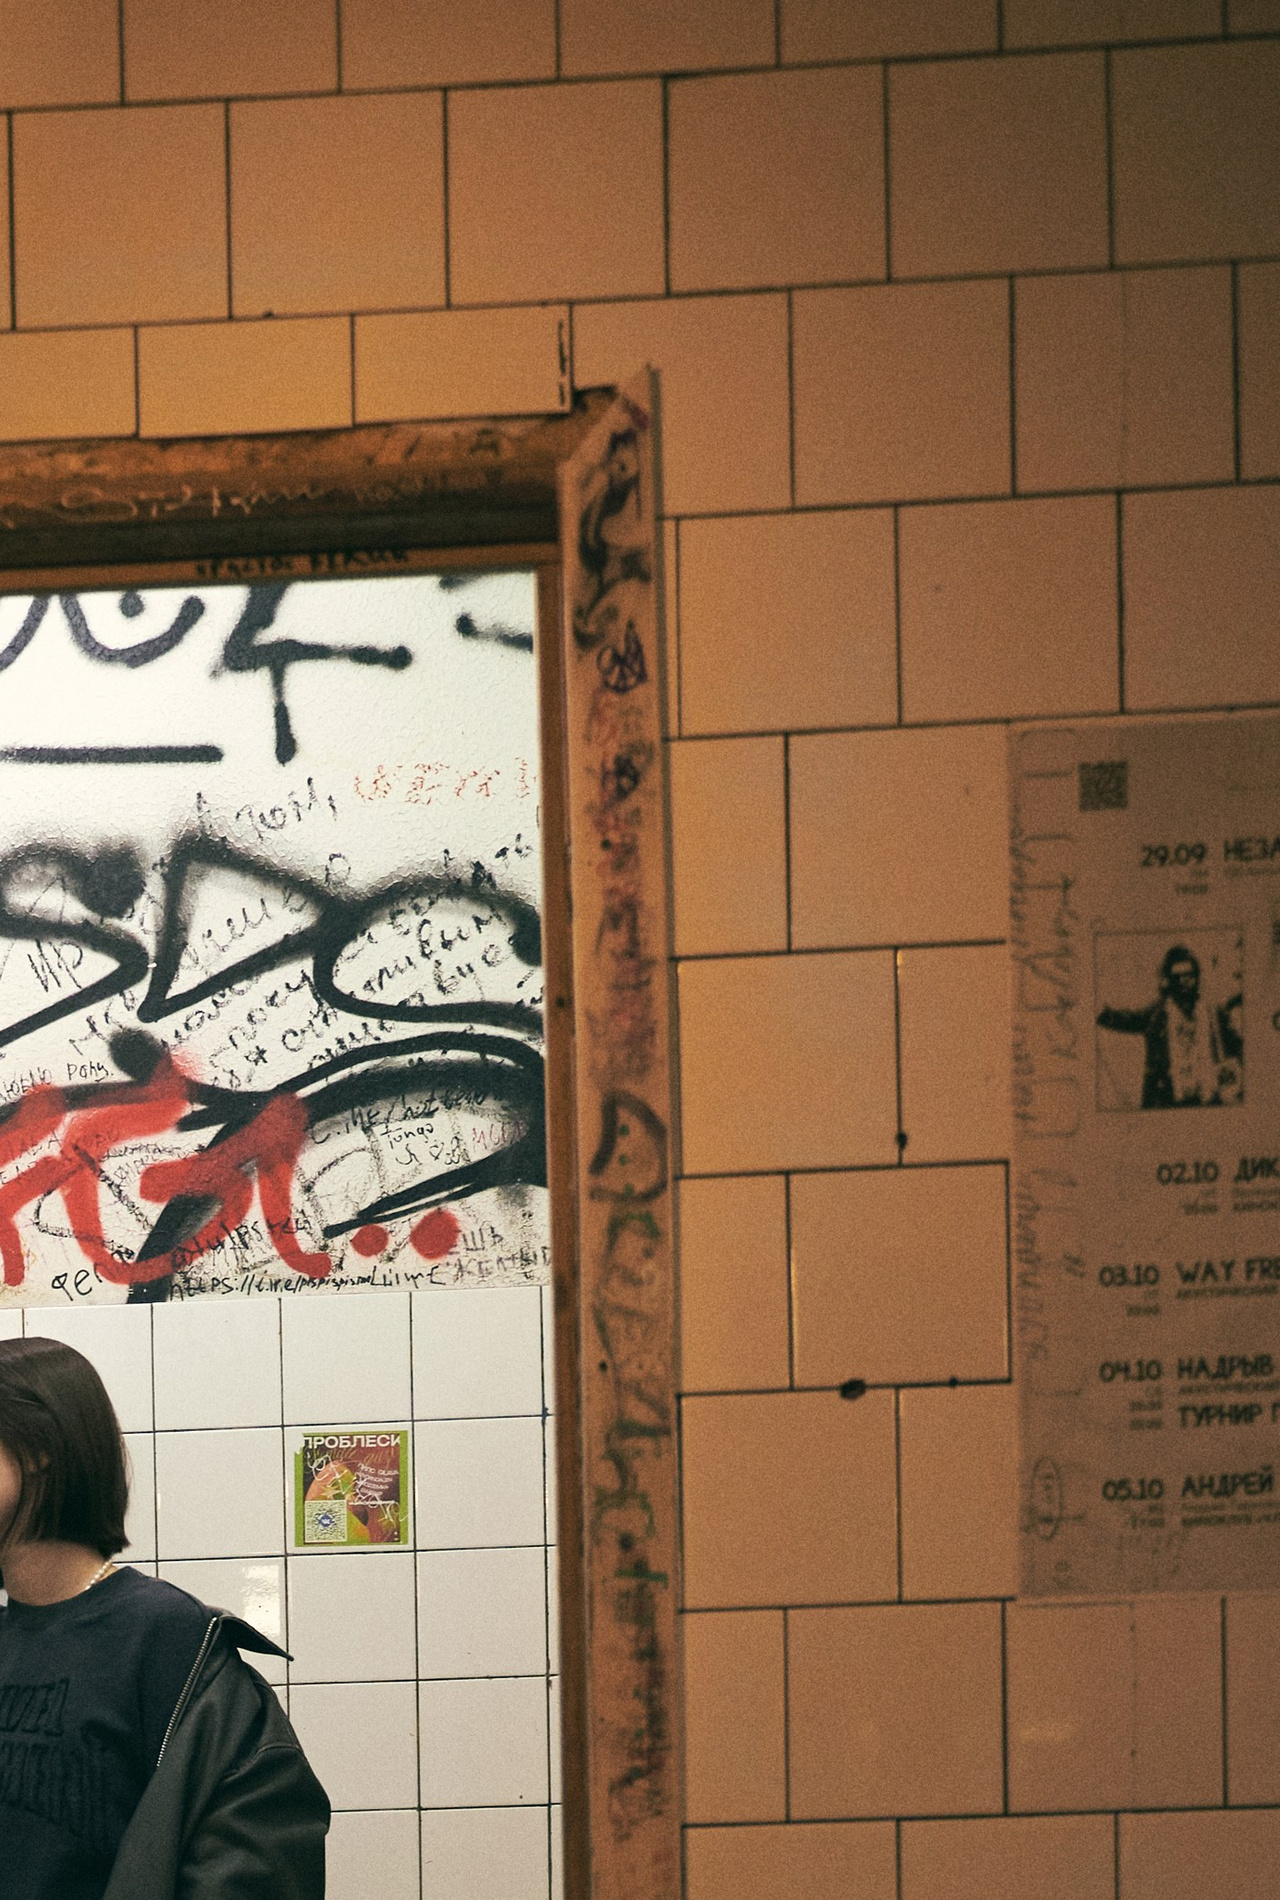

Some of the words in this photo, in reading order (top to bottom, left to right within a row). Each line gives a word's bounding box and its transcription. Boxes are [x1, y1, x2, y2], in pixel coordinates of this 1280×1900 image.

[1140, 842, 1207, 868] 29.09
[1156, 1161, 1219, 1185] 02.10
[1098, 1264, 1160, 1287] 03.10
[1175, 1260, 1236, 1283] WAY
[1099, 1359, 1162, 1382] 04.10
[1177, 1354, 1274, 1381] НАДРЫВ
[1178, 1402, 1263, 1428] ТУРНИР
[1102, 1478, 1165, 1501] 05.10
[1181, 1463, 1275, 1498] АНДРЕЙ
